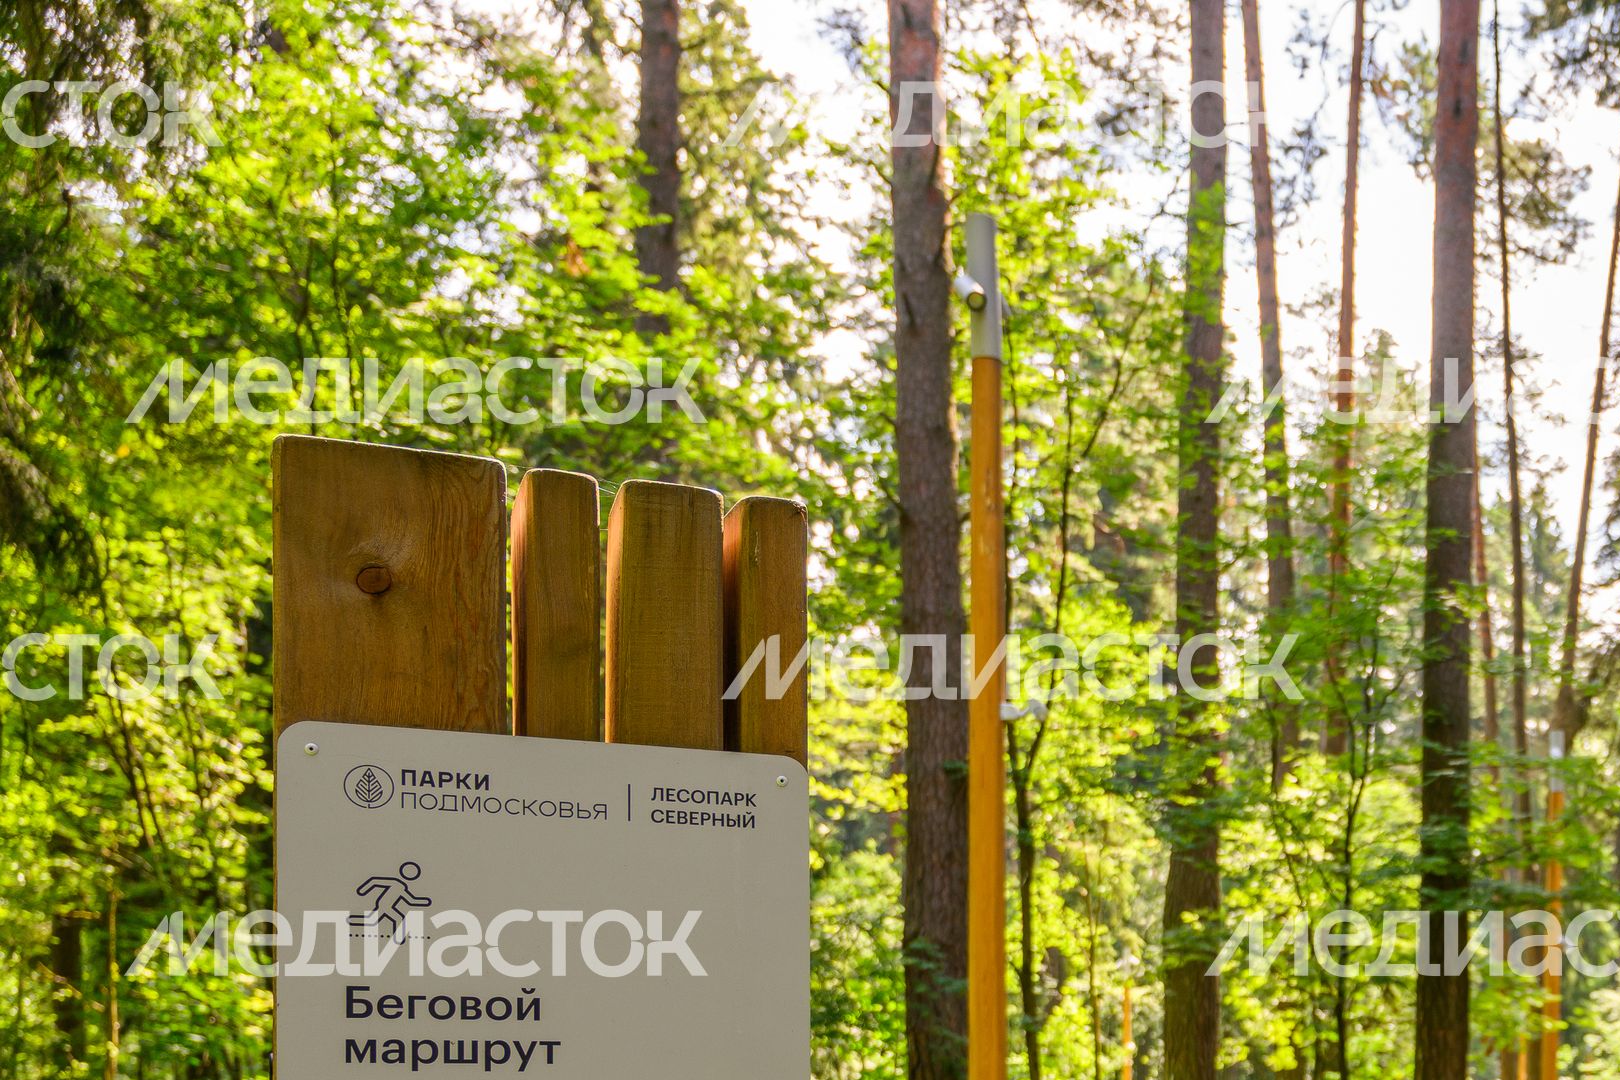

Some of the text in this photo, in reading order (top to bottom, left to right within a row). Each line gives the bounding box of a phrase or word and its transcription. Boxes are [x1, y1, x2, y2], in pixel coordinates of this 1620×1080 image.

[401, 768, 490, 792] ПАРКИ
[400, 792, 608, 821] ПОДМОСКОВЬЯ
[651, 787, 757, 808] ЛЕСОПАРК
[651, 809, 756, 830] СЕВЕРНЫЙ
[345, 985, 542, 1022] Беговой
[345, 1039, 561, 1073] маршрут
